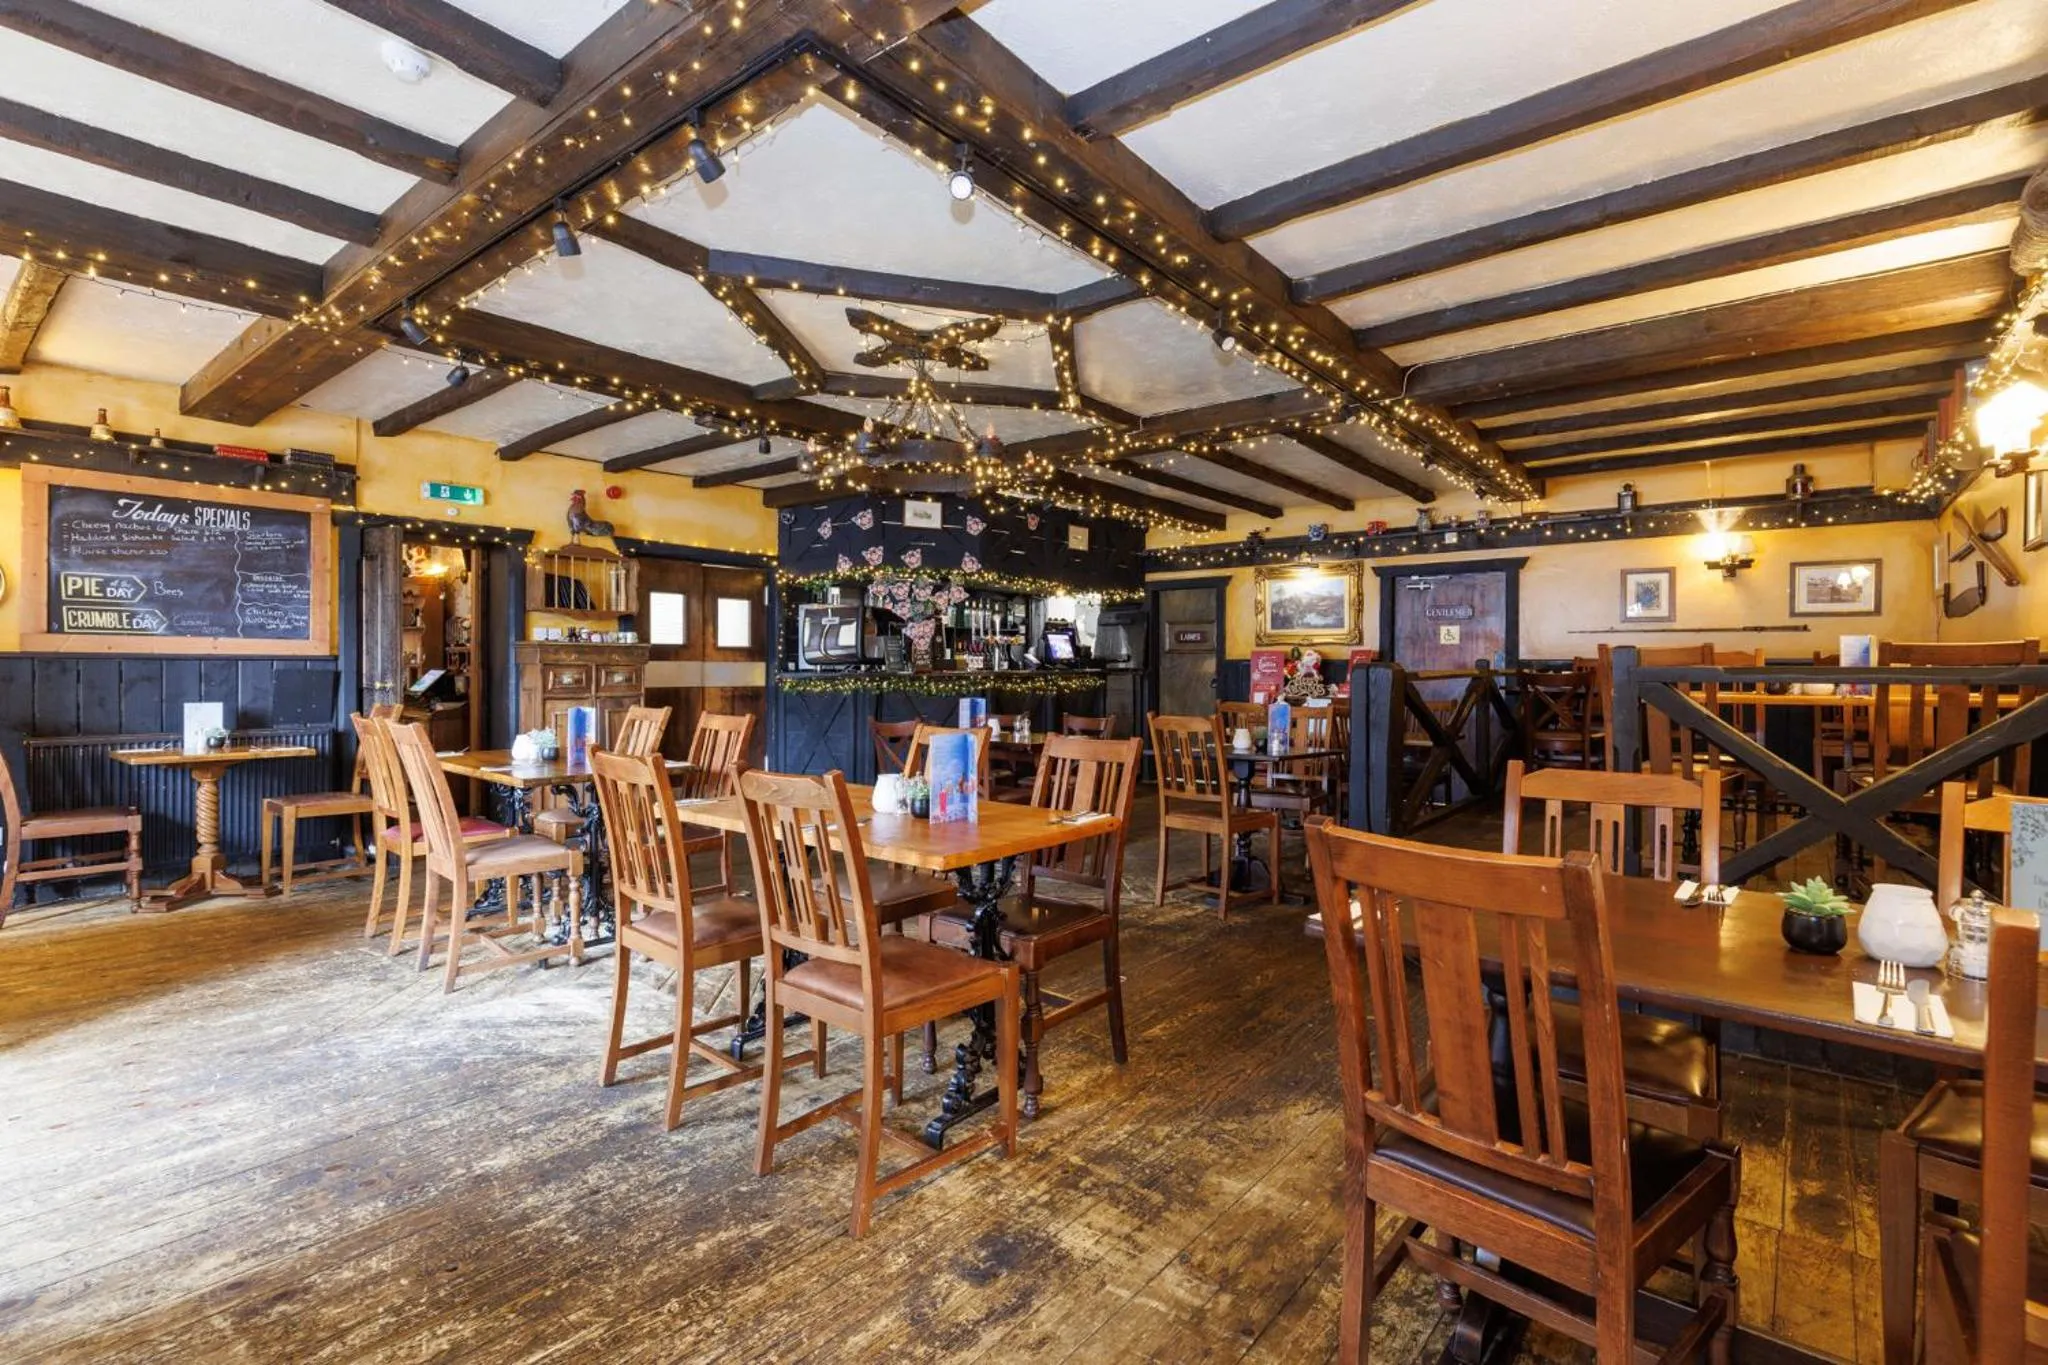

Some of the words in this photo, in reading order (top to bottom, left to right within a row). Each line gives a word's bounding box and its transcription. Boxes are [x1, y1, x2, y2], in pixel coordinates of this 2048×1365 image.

[112, 498, 190, 530] Today's
[194, 506, 250, 531] SPECIALS
[67, 576, 104, 598] PIE
[106, 587, 135, 598] DAY
[67, 609, 131, 629] CRUMBLE
[132, 618, 160, 629] DAY
